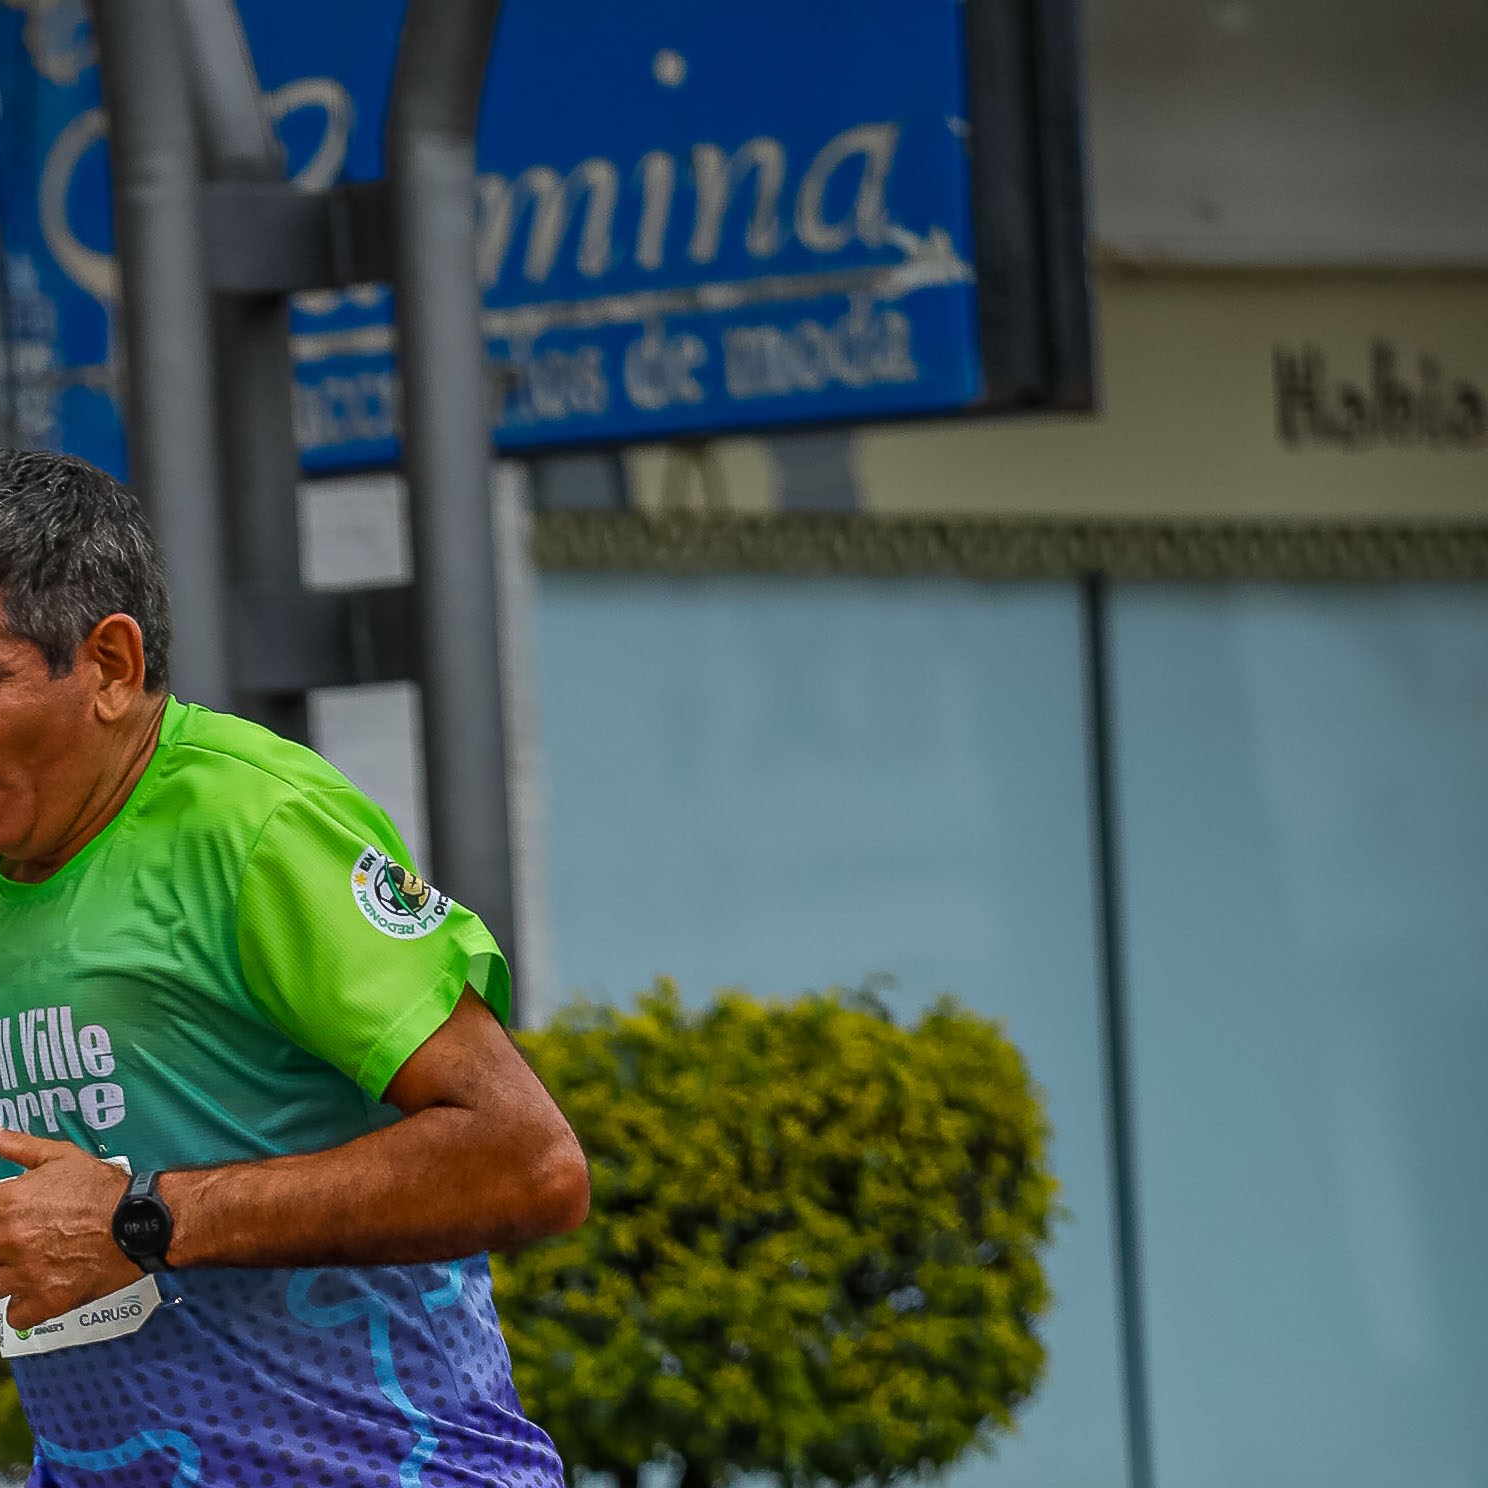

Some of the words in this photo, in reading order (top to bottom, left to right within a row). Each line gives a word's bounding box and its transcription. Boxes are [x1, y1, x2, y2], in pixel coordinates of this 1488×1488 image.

[624, 312, 707, 410] de
[723, 292, 918, 400] moda
[357, 890, 415, 935] REDONDA
[417, 914, 437, 931] LA
[18, 1006, 115, 1084] Ville
[79, 1302, 143, 1327] CARUSO
